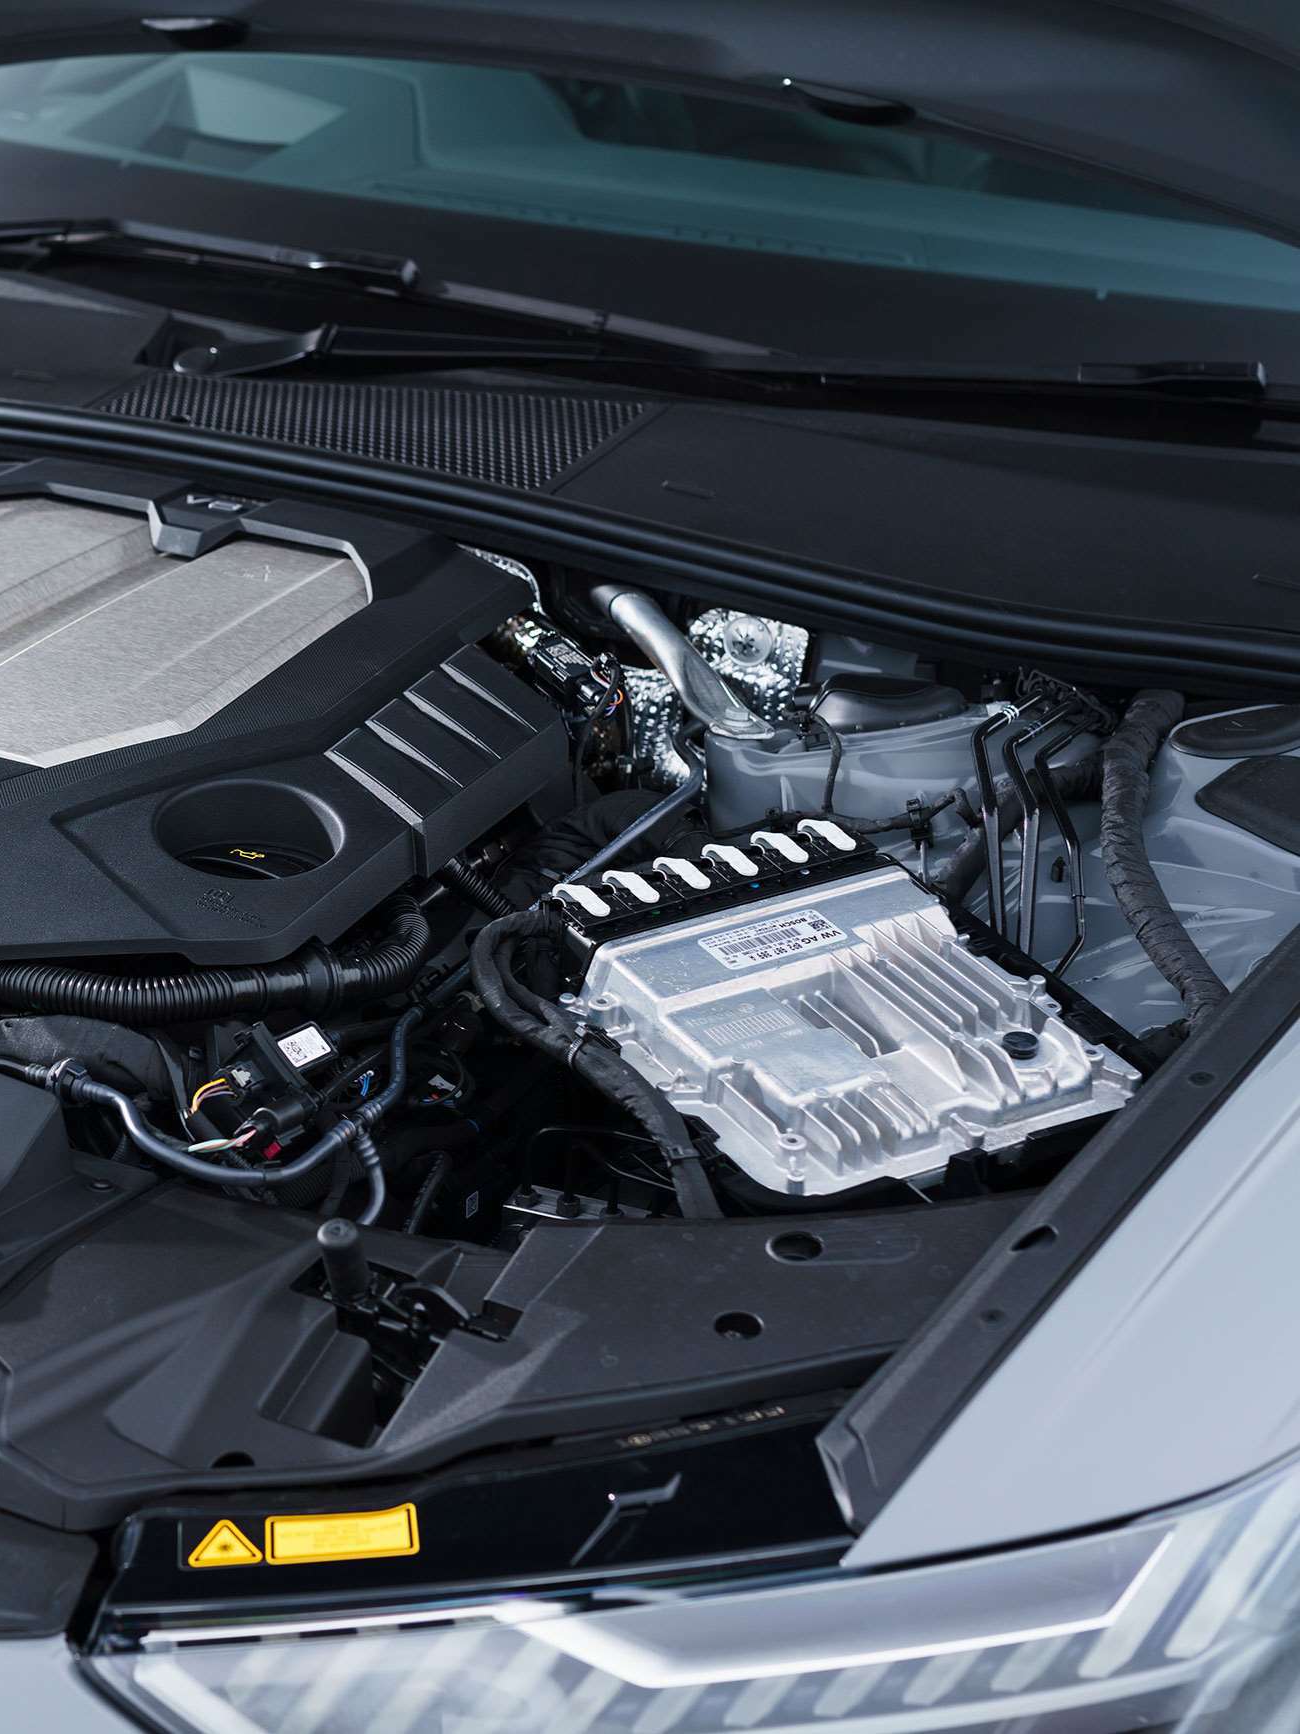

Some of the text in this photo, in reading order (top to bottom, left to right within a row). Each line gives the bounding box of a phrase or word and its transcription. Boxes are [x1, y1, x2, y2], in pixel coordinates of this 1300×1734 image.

[779, 917, 807, 928] BOSCH
[820, 930, 842, 939] VW
[801, 935, 818, 945] AG
